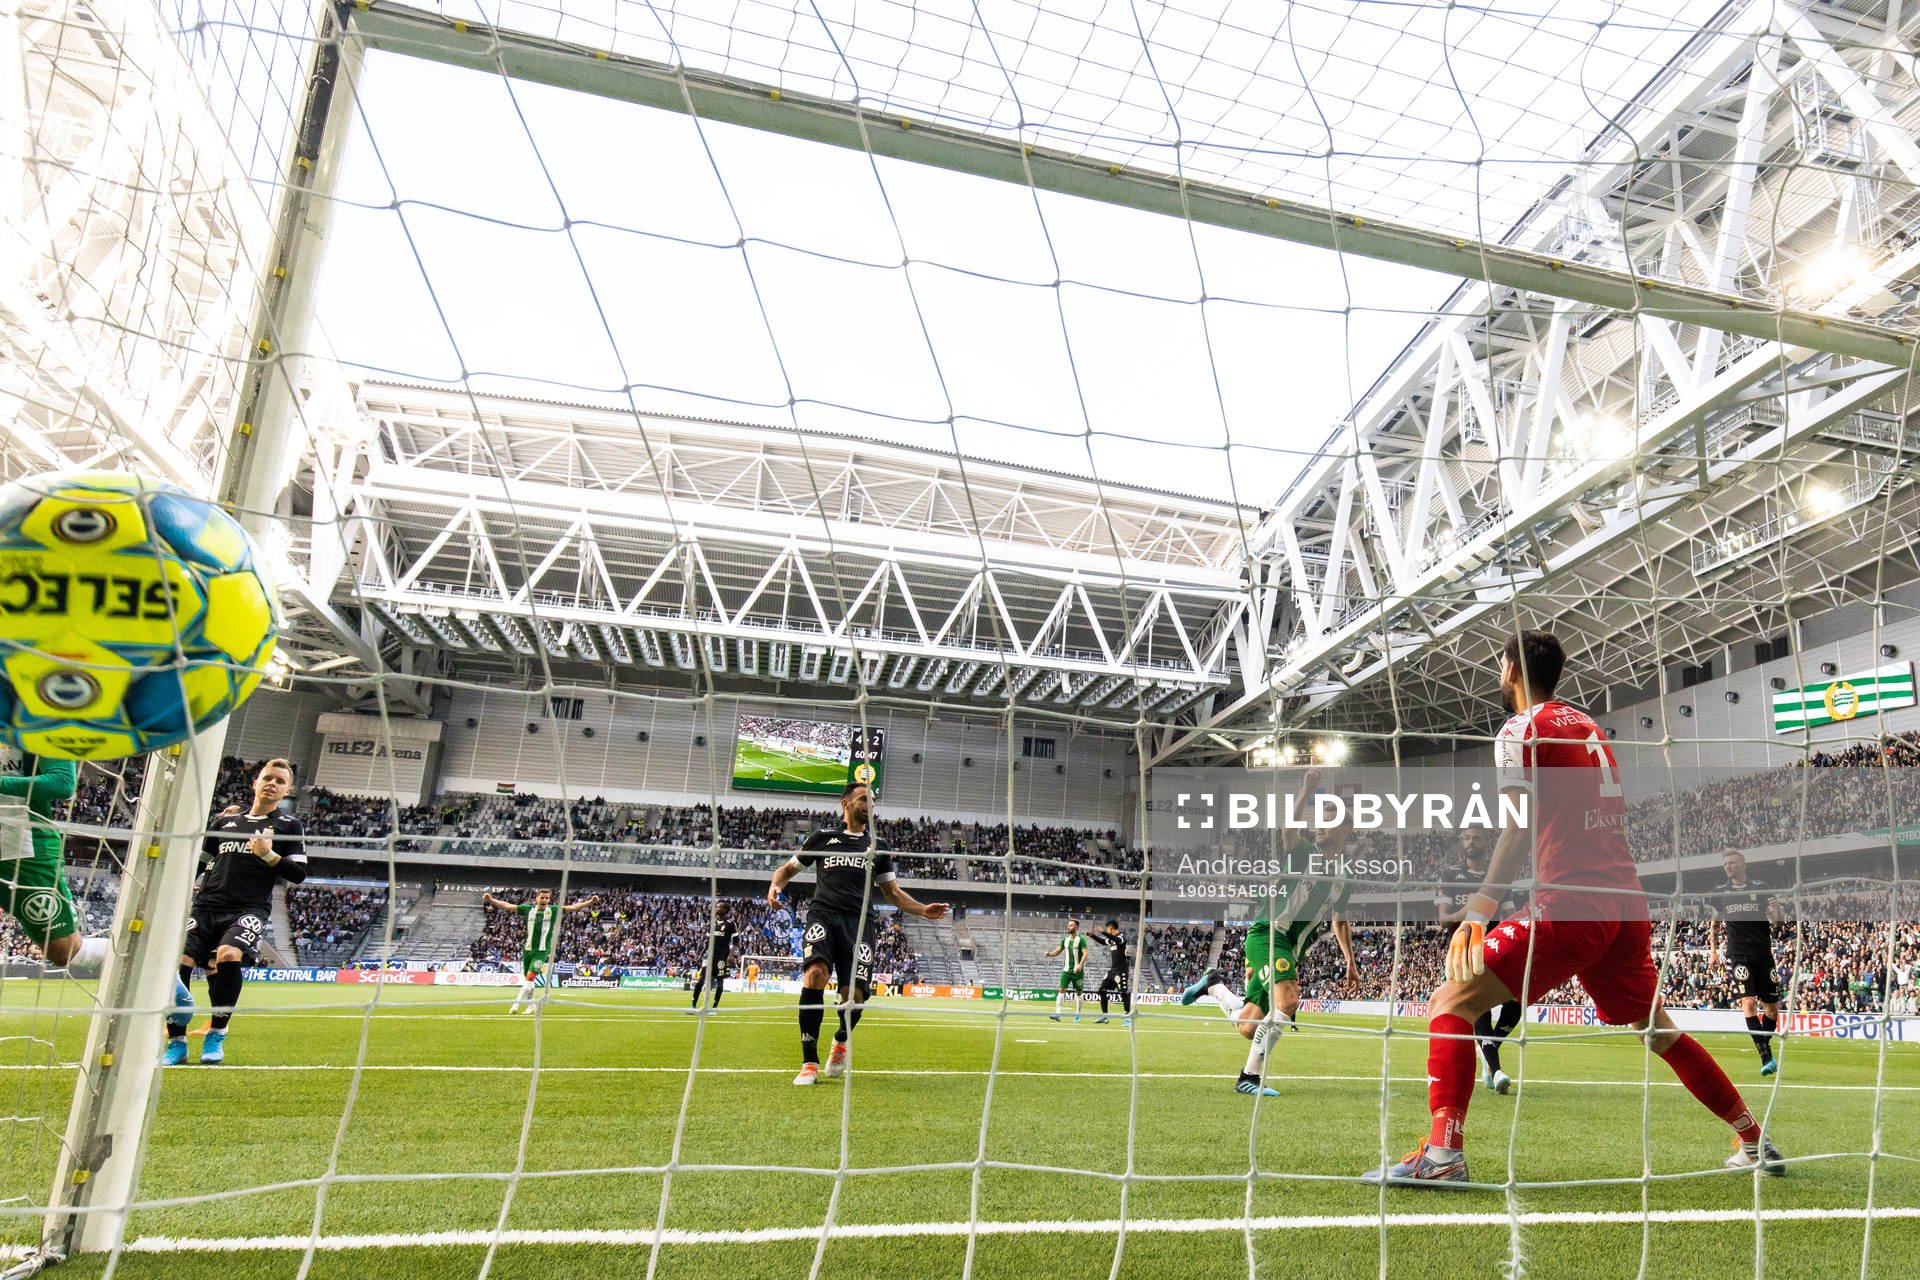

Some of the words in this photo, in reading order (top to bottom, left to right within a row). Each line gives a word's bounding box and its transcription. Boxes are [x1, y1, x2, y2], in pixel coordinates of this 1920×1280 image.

[0, 572, 179, 622] SELEC
[855, 735, 863, 744] 4
[872, 736, 880, 746] 2
[328, 741, 374, 756] TELE2
[376, 746, 422, 760] Arena
[854, 750, 878, 760] 6047
[1584, 730, 1623, 798] 1
[1894, 829, 1920, 842] FOTBO
[218, 841, 255, 855] ERNE
[823, 855, 876, 870] SERNEK
[240, 930, 256, 942] 20
[247, 967, 267, 980] THE
[269, 969, 315, 982] CENTRAL
[316, 970, 337, 982] BAR
[358, 970, 415, 984] Scandic
[857, 965, 869, 977] 26
[884, 985, 902, 997] XL
[910, 985, 936, 994] renta
[950, 987, 975, 996] renta
[1142, 995, 1182, 1004] INTERSP
[1303, 1000, 1341, 1013] INTERSPORT
[1404, 1003, 1429, 1017] INTER
[1547, 1008, 1602, 1026] INTERSP
[1776, 1013, 1904, 1041] INTERSPORT
